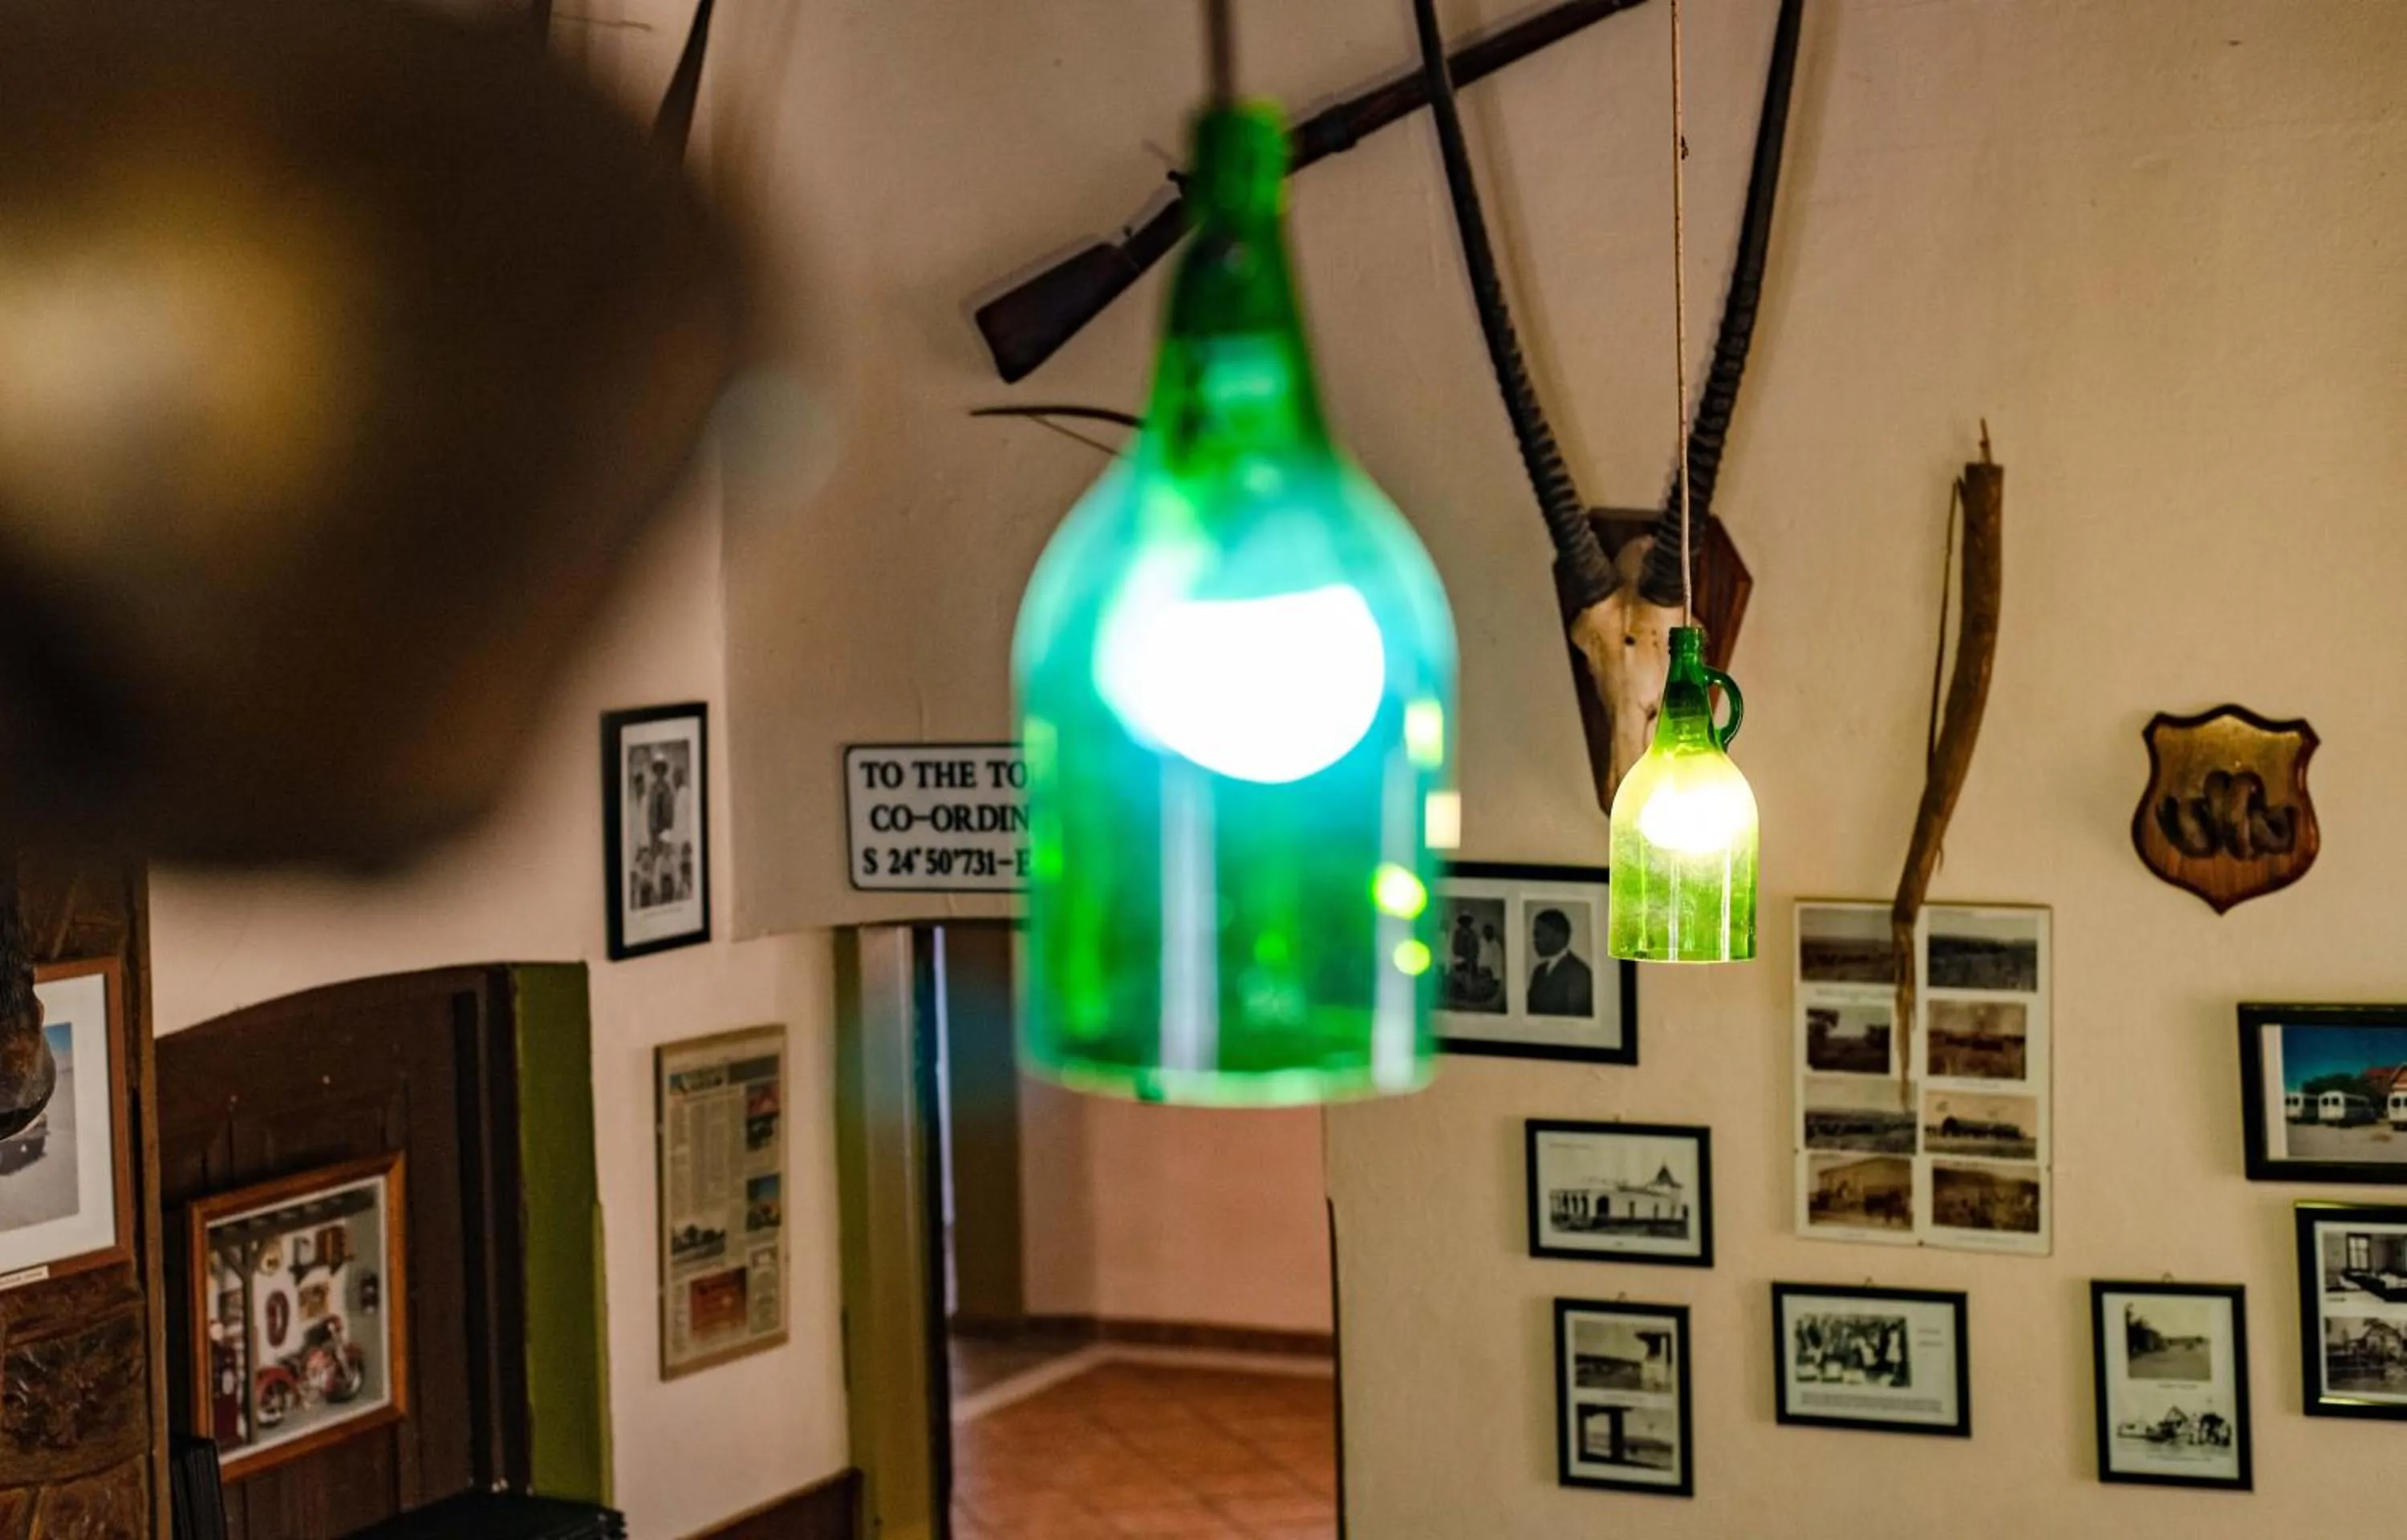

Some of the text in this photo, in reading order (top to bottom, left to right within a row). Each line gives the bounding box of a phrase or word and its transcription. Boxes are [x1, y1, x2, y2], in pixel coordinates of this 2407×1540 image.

[859, 760, 1030, 789] TO THE TO
[870, 804, 1029, 833] CO-ORDIN
[862, 846, 878, 875] S
